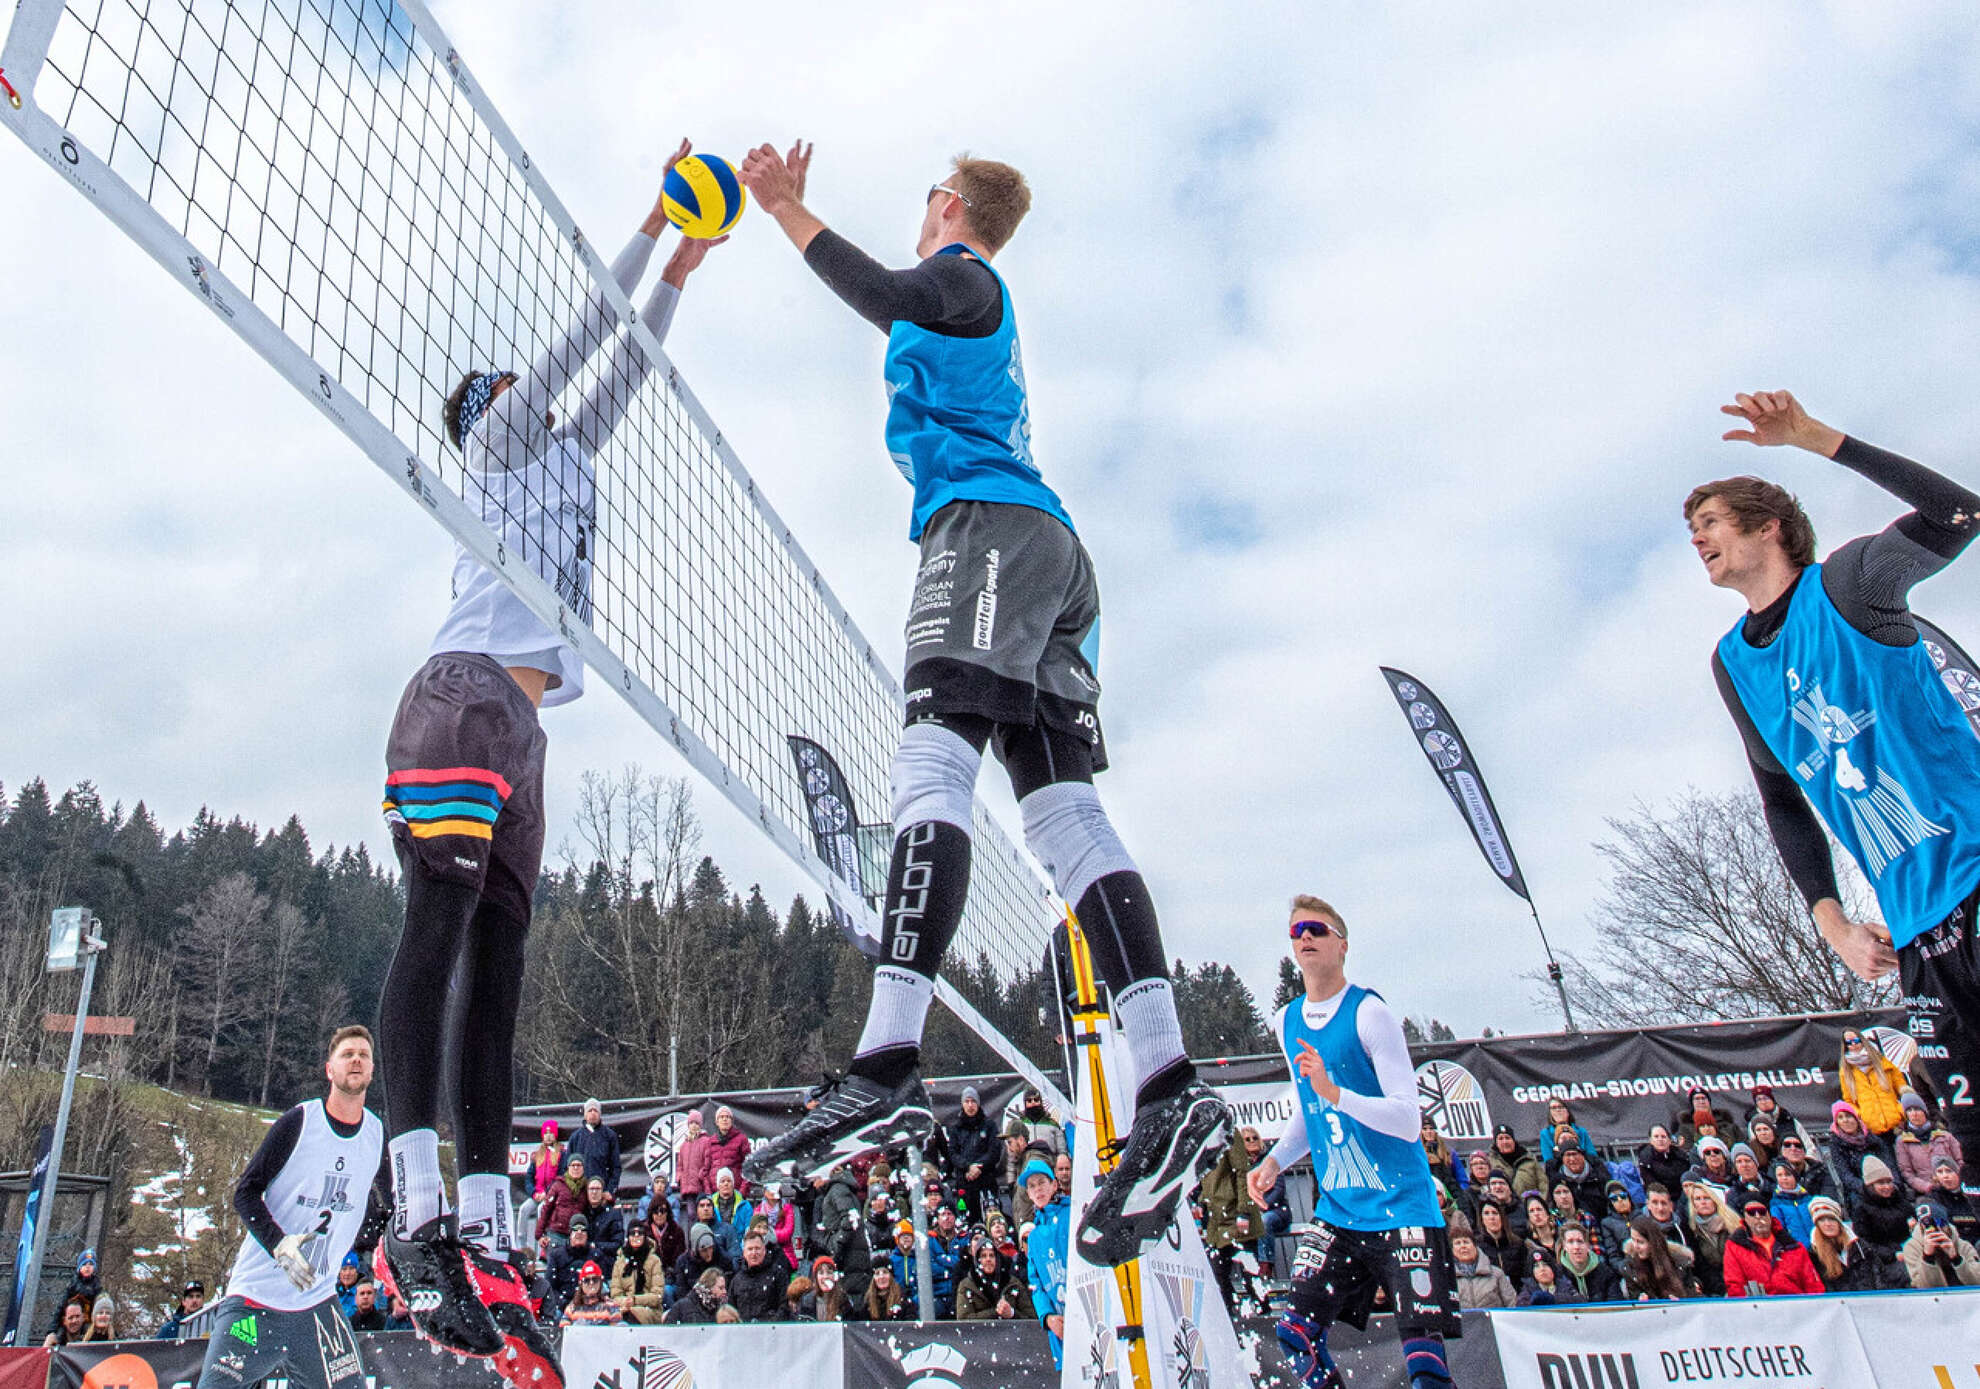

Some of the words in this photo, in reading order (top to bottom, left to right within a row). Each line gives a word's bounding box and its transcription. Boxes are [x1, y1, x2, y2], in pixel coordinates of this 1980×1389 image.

[1512, 1066, 1825, 1103] GERMAN-SNOWVOLLEYBALL.DE
[1947, 1073, 1975, 1105] 2
[1325, 1113, 1344, 1145] 3
[313, 1209, 332, 1235] 2
[1397, 1247, 1434, 1264] WOLF
[1660, 1345, 1813, 1382] DEUTSCHER
